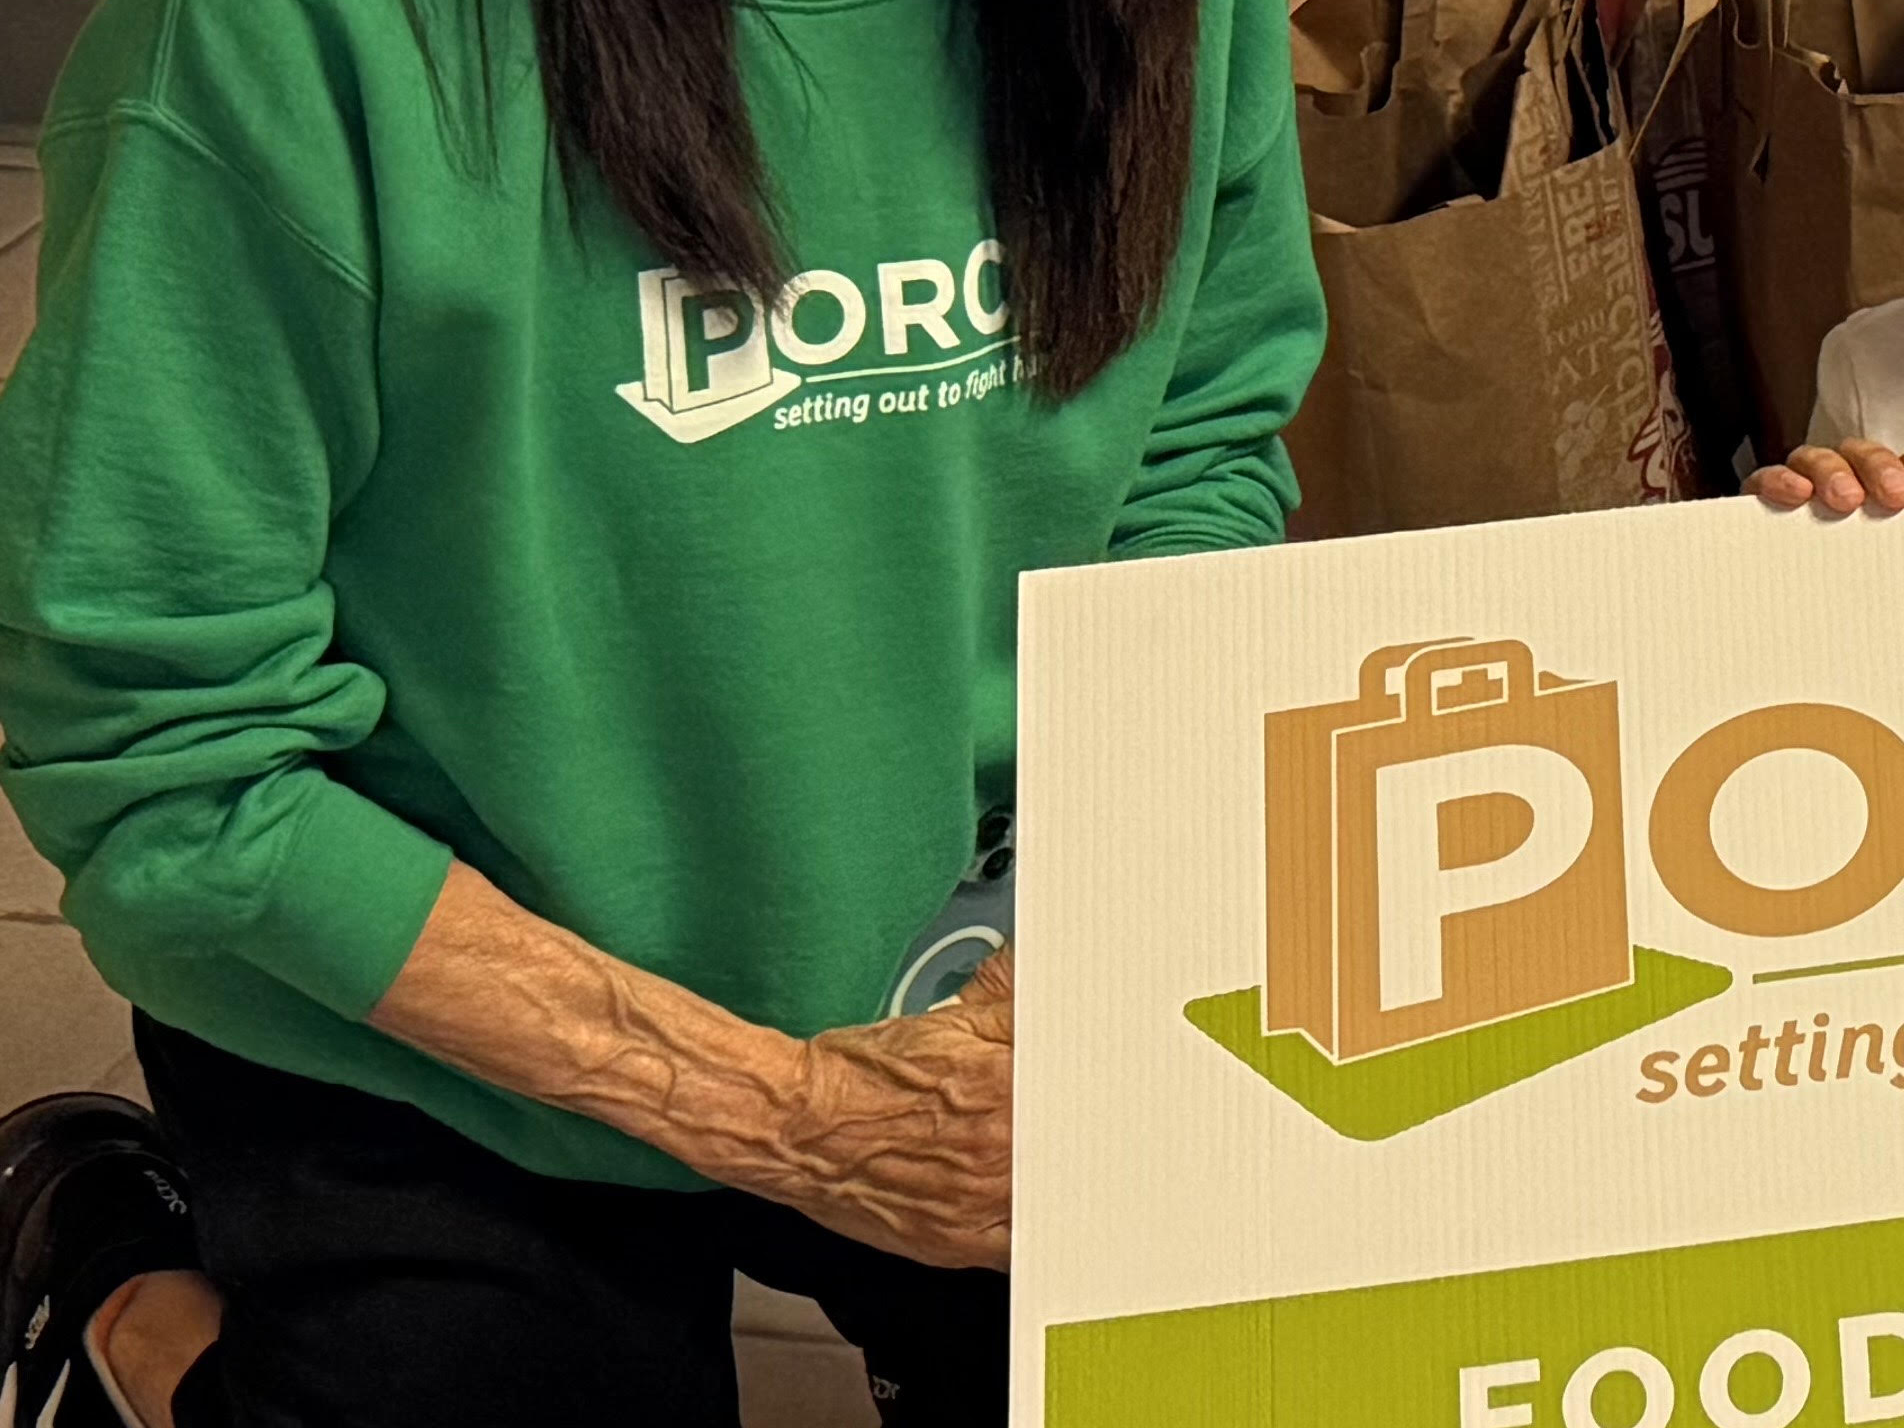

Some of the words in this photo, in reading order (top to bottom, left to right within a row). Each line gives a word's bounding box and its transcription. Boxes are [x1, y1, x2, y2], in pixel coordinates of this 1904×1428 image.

[773, 391, 870, 430] setting
[878, 384, 930, 414] out
[937, 381, 962, 409] to
[964, 360, 1007, 401] fight
